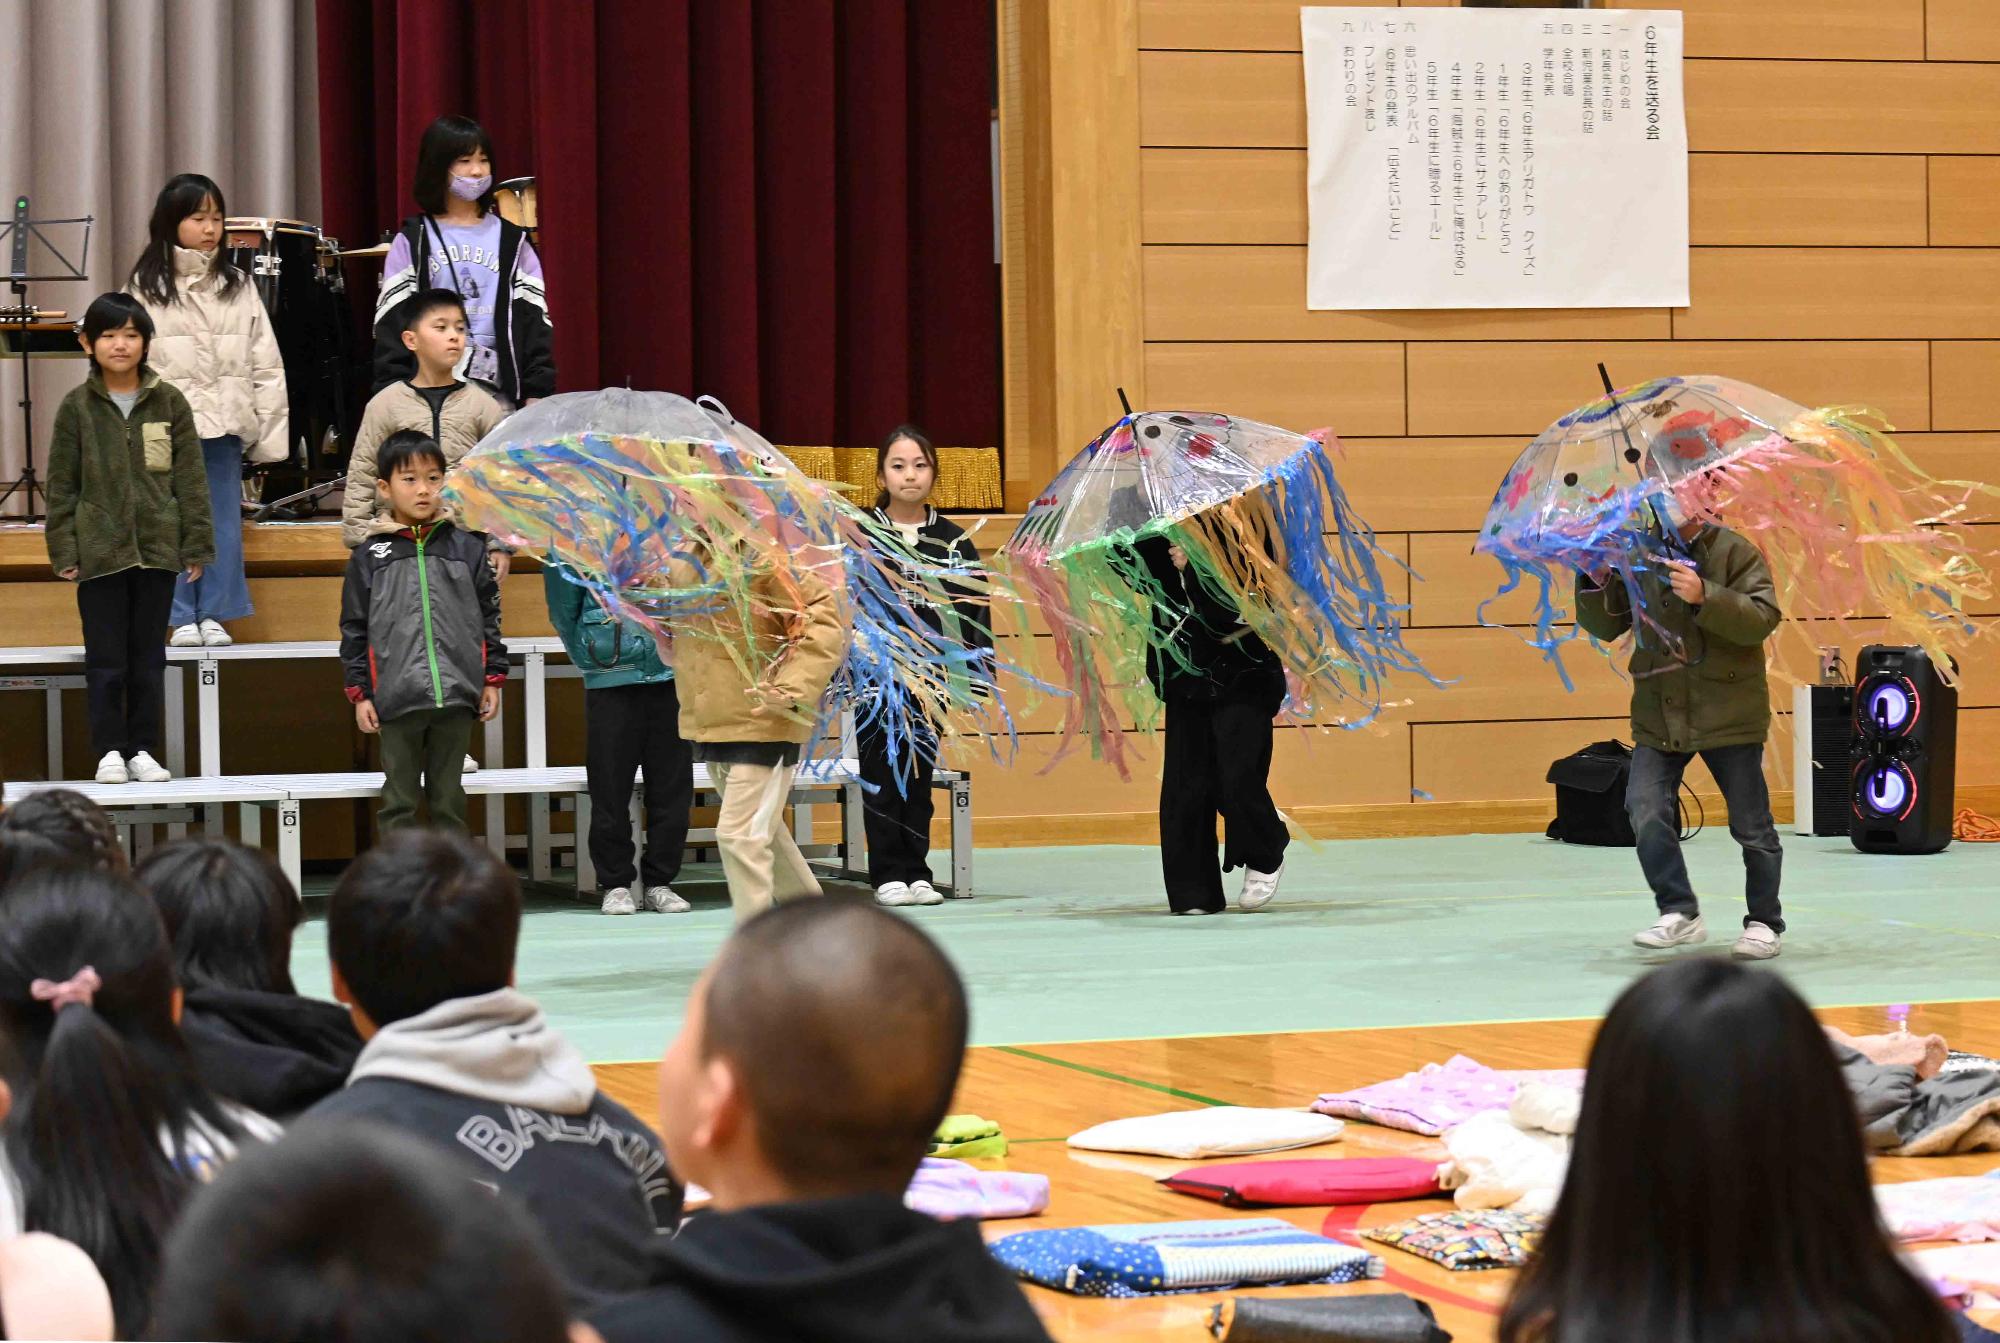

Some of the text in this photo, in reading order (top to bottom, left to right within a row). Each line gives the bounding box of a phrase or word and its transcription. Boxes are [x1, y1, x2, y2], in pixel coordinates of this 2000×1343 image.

[1342, 22, 1357, 107] 九 おわりの会
[1383, 22, 1396, 34] 七
[1542, 23, 1555, 96] 五 学年発表
[1561, 23, 1575, 97] 四 全校合唱
[1581, 23, 1593, 35] 三
[1384, 48, 1398, 127] 6年生の発表
[1404, 45, 1420, 144] 思い出のアルバム
[1601, 24, 1614, 123] 二 校長先生の話
[1618, 48, 1632, 109] はじめの会
[1644, 25, 1661, 140] 6年生を送る会
